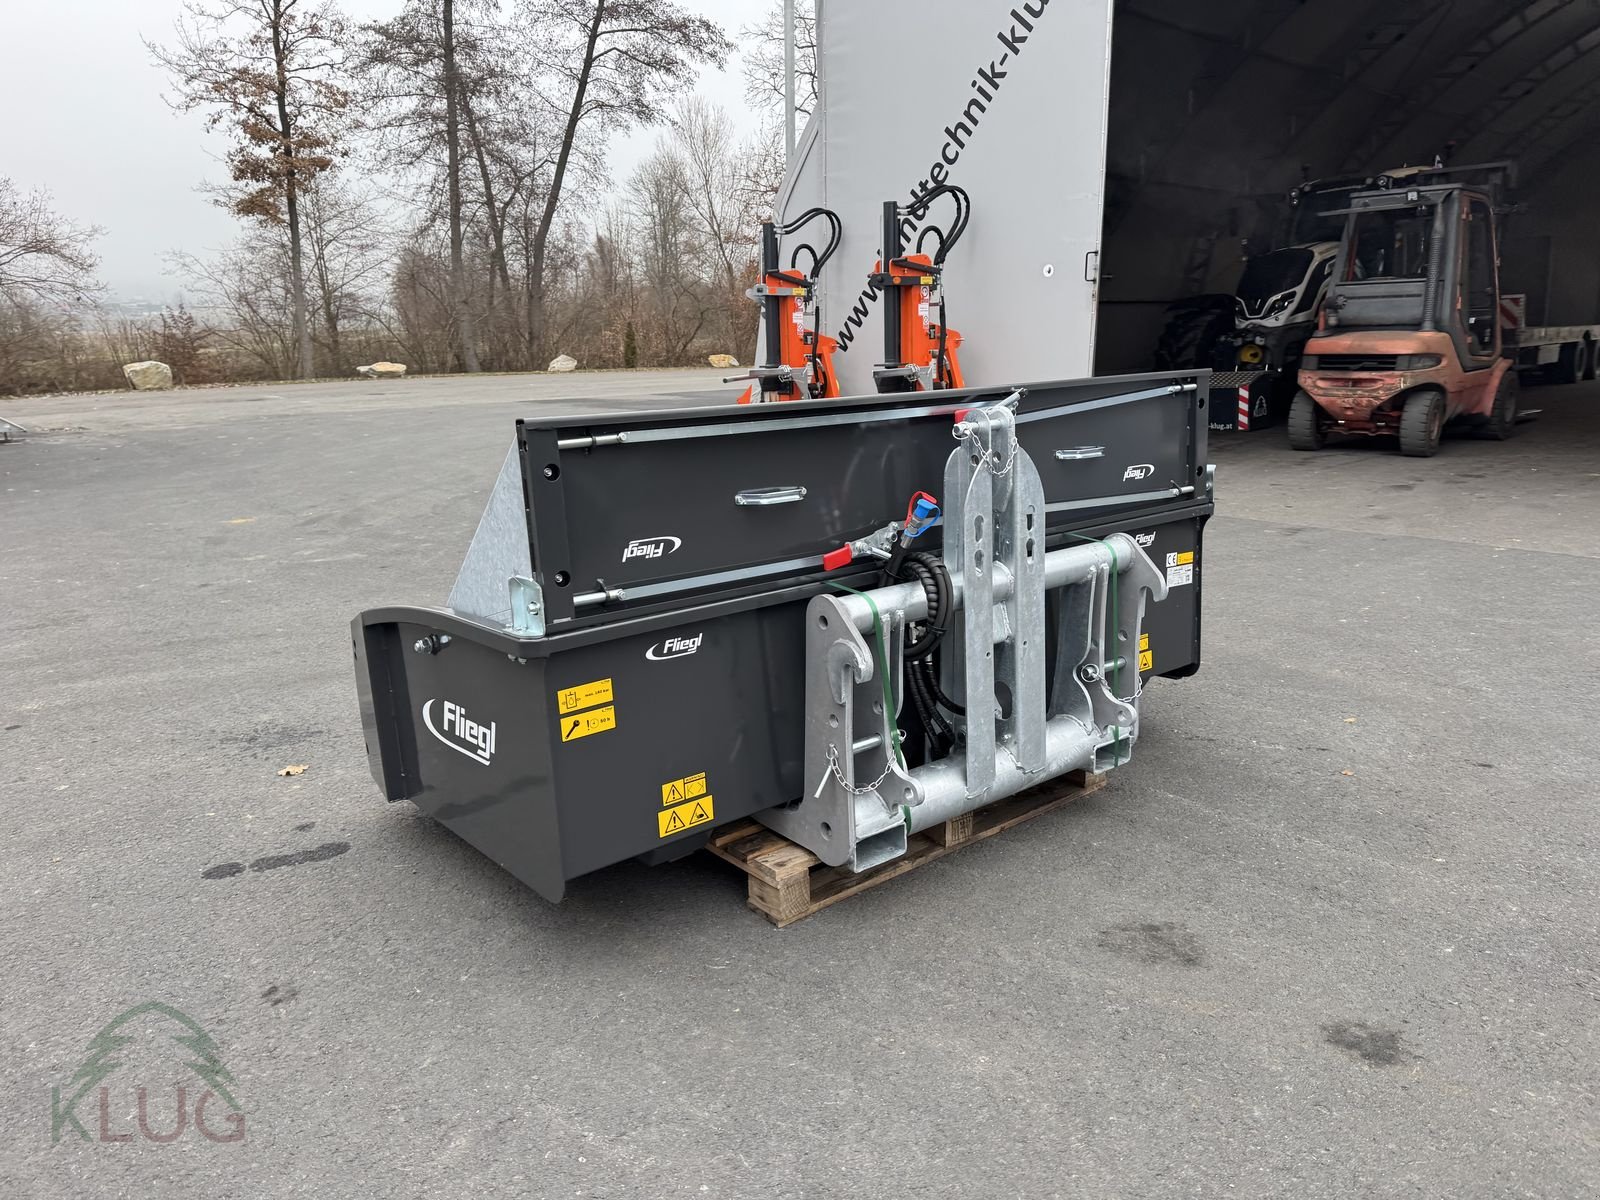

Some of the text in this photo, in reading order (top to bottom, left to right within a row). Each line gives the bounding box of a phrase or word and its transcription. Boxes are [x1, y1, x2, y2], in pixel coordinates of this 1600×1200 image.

[1123, 468, 1146, 482] Fliegl
[622, 542, 665, 562] Fliegl
[663, 632, 704, 654] Fliegl
[443, 700, 496, 760] Fliegl
